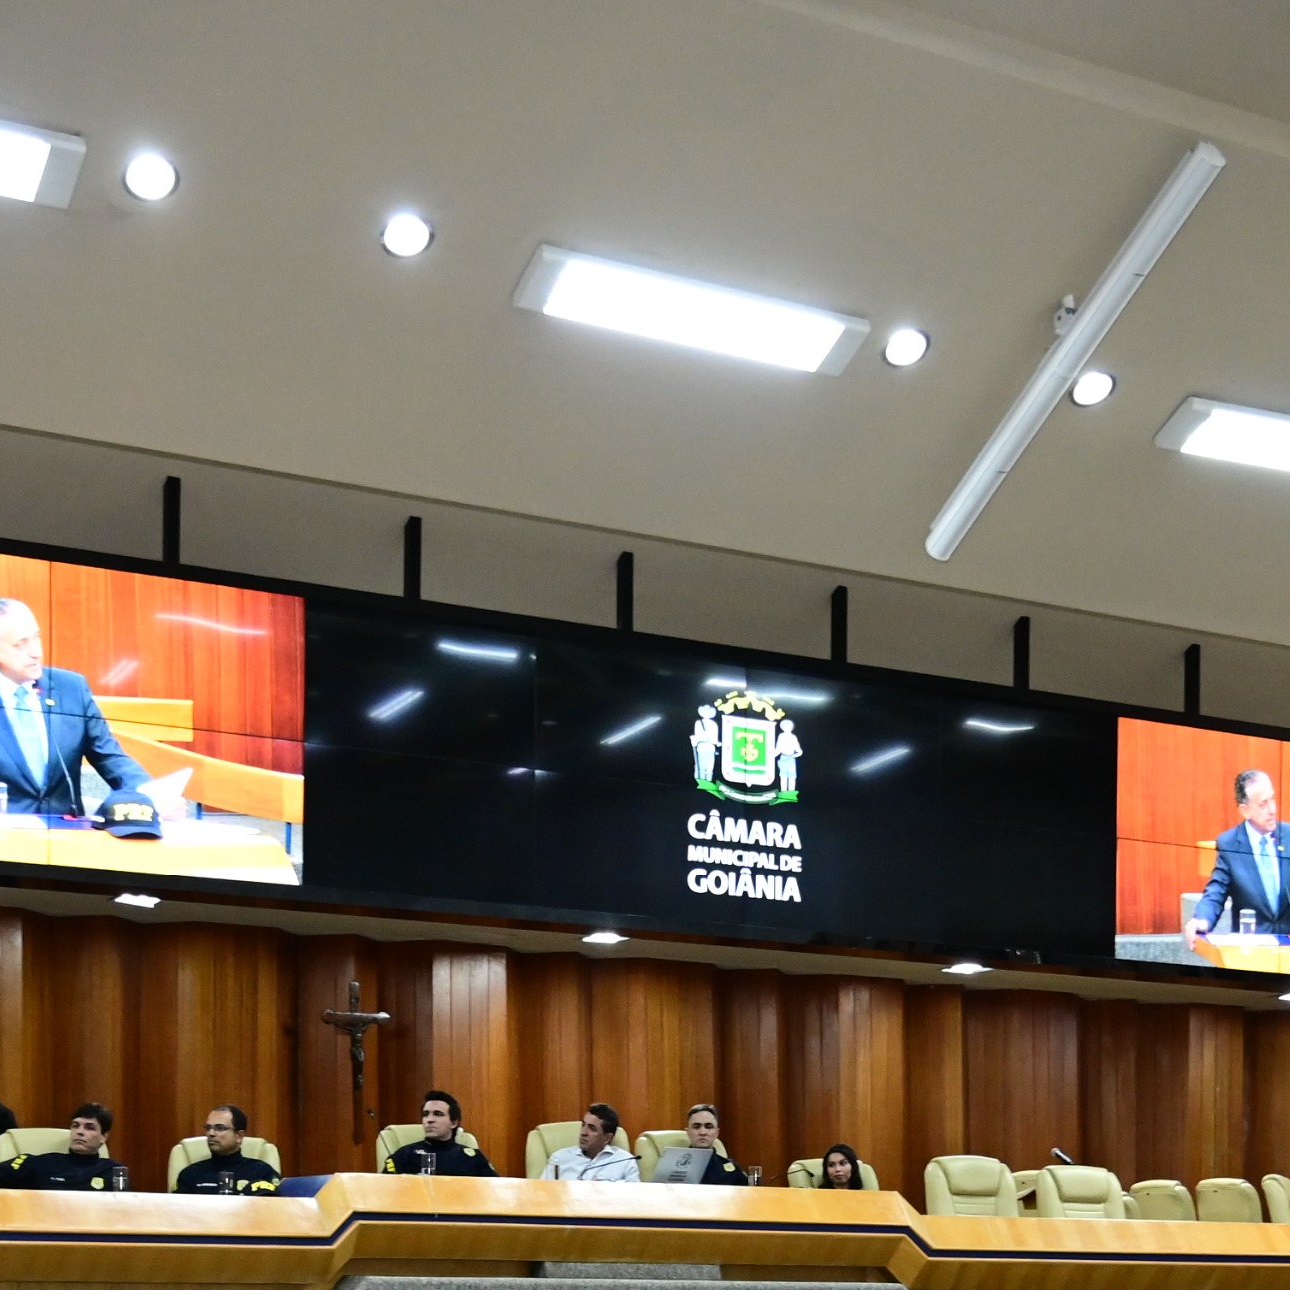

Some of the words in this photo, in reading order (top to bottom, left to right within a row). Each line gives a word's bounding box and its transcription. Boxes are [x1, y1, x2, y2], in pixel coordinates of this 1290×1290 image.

[687, 809, 802, 850] CÂMARA
[687, 844, 779, 871] MUNICIPAL
[779, 854, 803, 873] DE
[687, 867, 802, 903] GOIÂNIA
